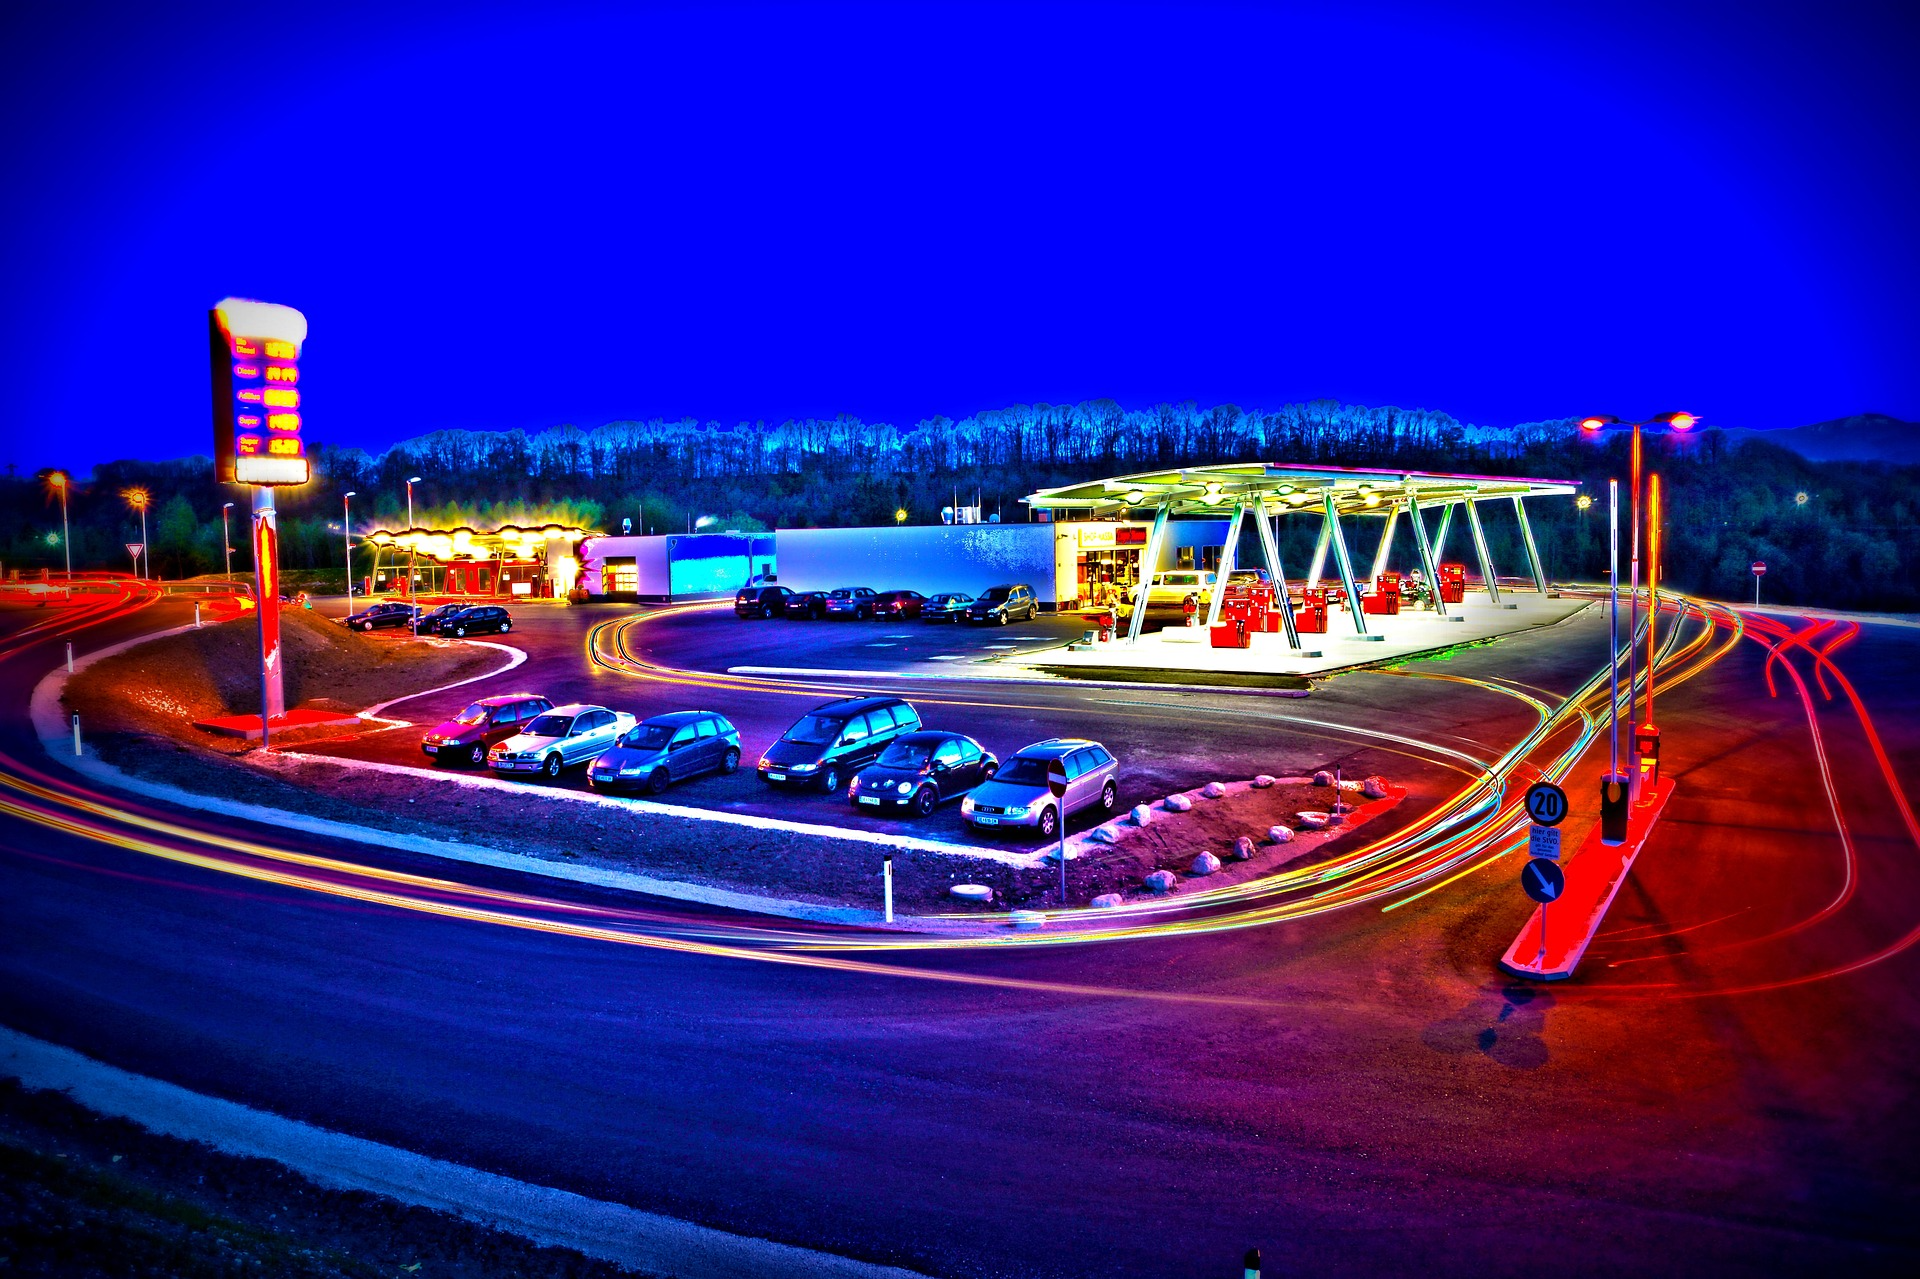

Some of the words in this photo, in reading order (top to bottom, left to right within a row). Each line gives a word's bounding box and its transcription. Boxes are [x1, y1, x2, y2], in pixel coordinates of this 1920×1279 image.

[236, 346, 256, 354] Diesel
[237, 367, 257, 375] Diesel
[239, 416, 258, 426] Super
[240, 437, 259, 445] Super
[1535, 792, 1557, 816] 20
[1532, 827, 1545, 835] hier
[1547, 829, 1558, 837] gilt
